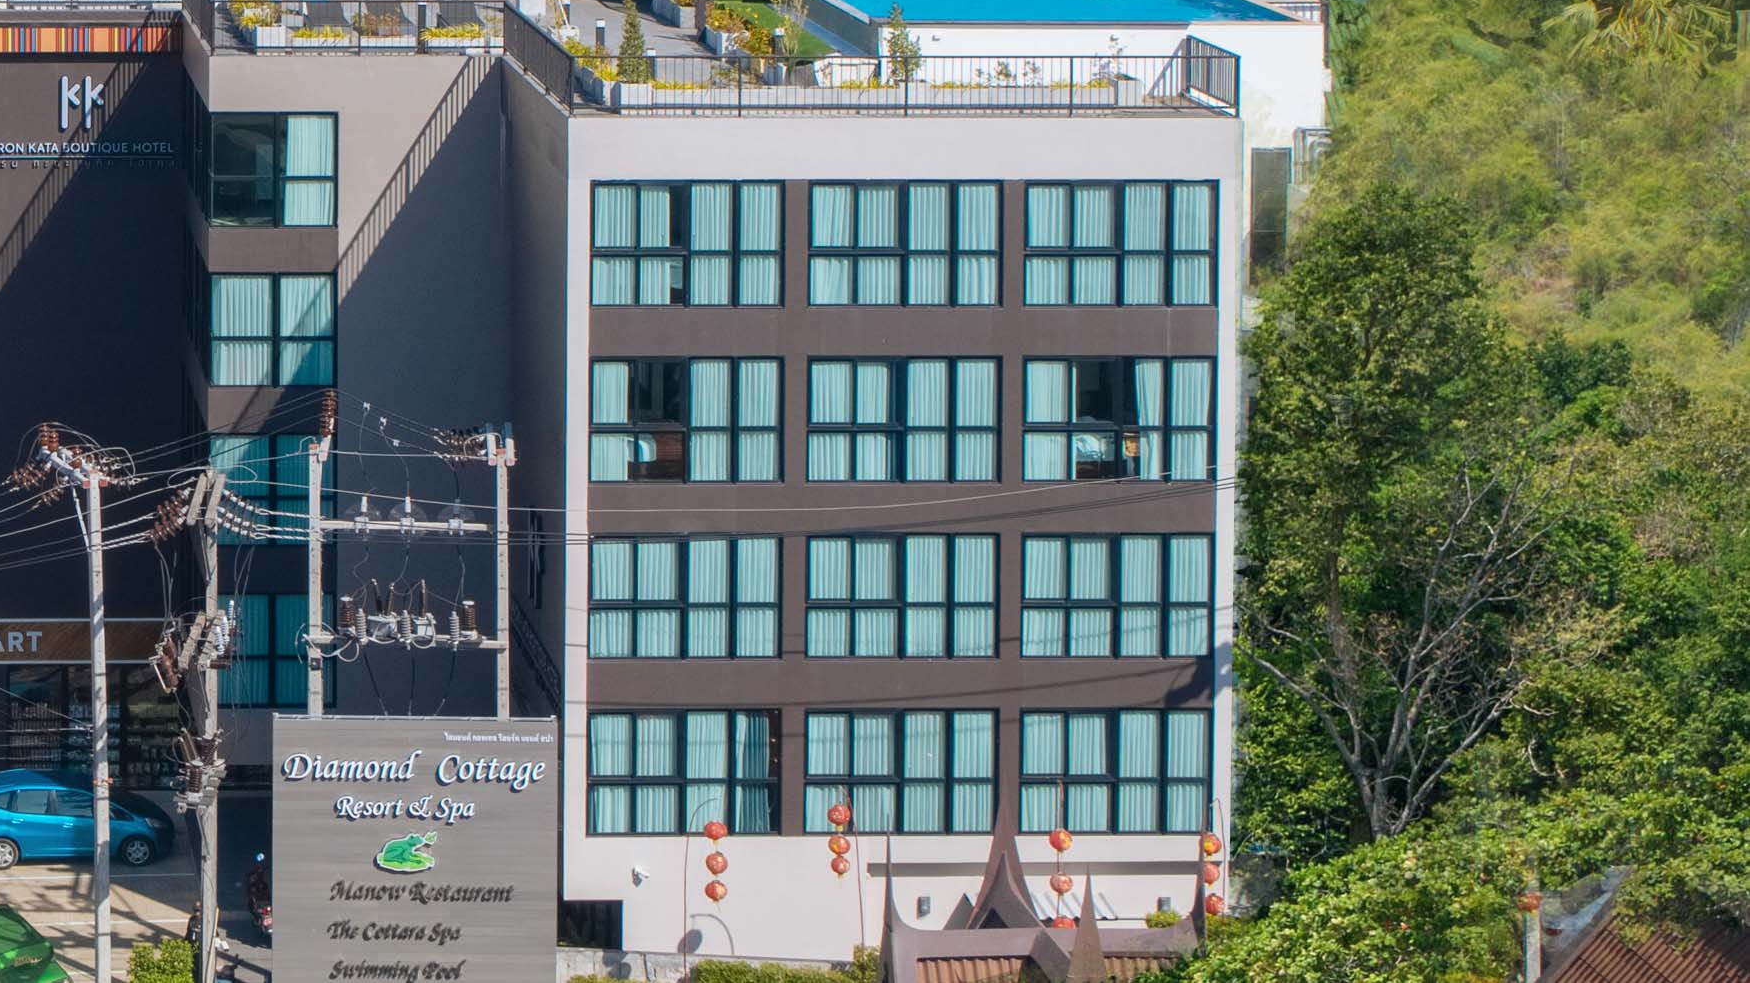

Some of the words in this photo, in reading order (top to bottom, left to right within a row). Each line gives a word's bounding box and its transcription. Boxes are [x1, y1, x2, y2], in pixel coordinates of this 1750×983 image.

[28, 142, 58, 154] KATA
[63, 142, 129, 154] BOUTIQUE
[133, 142, 174, 154] HOTEL
[284, 750, 422, 781] Diamond
[437, 755, 546, 790] Cottage
[336, 795, 404, 819] Resort
[408, 795, 433, 818] &
[435, 797, 475, 824] Spa
[408, 881, 514, 905] Restaurant
[327, 920, 359, 940] The
[427, 923, 461, 945] Spa
[328, 960, 419, 983] Swimming
[422, 960, 466, 980] Pool
